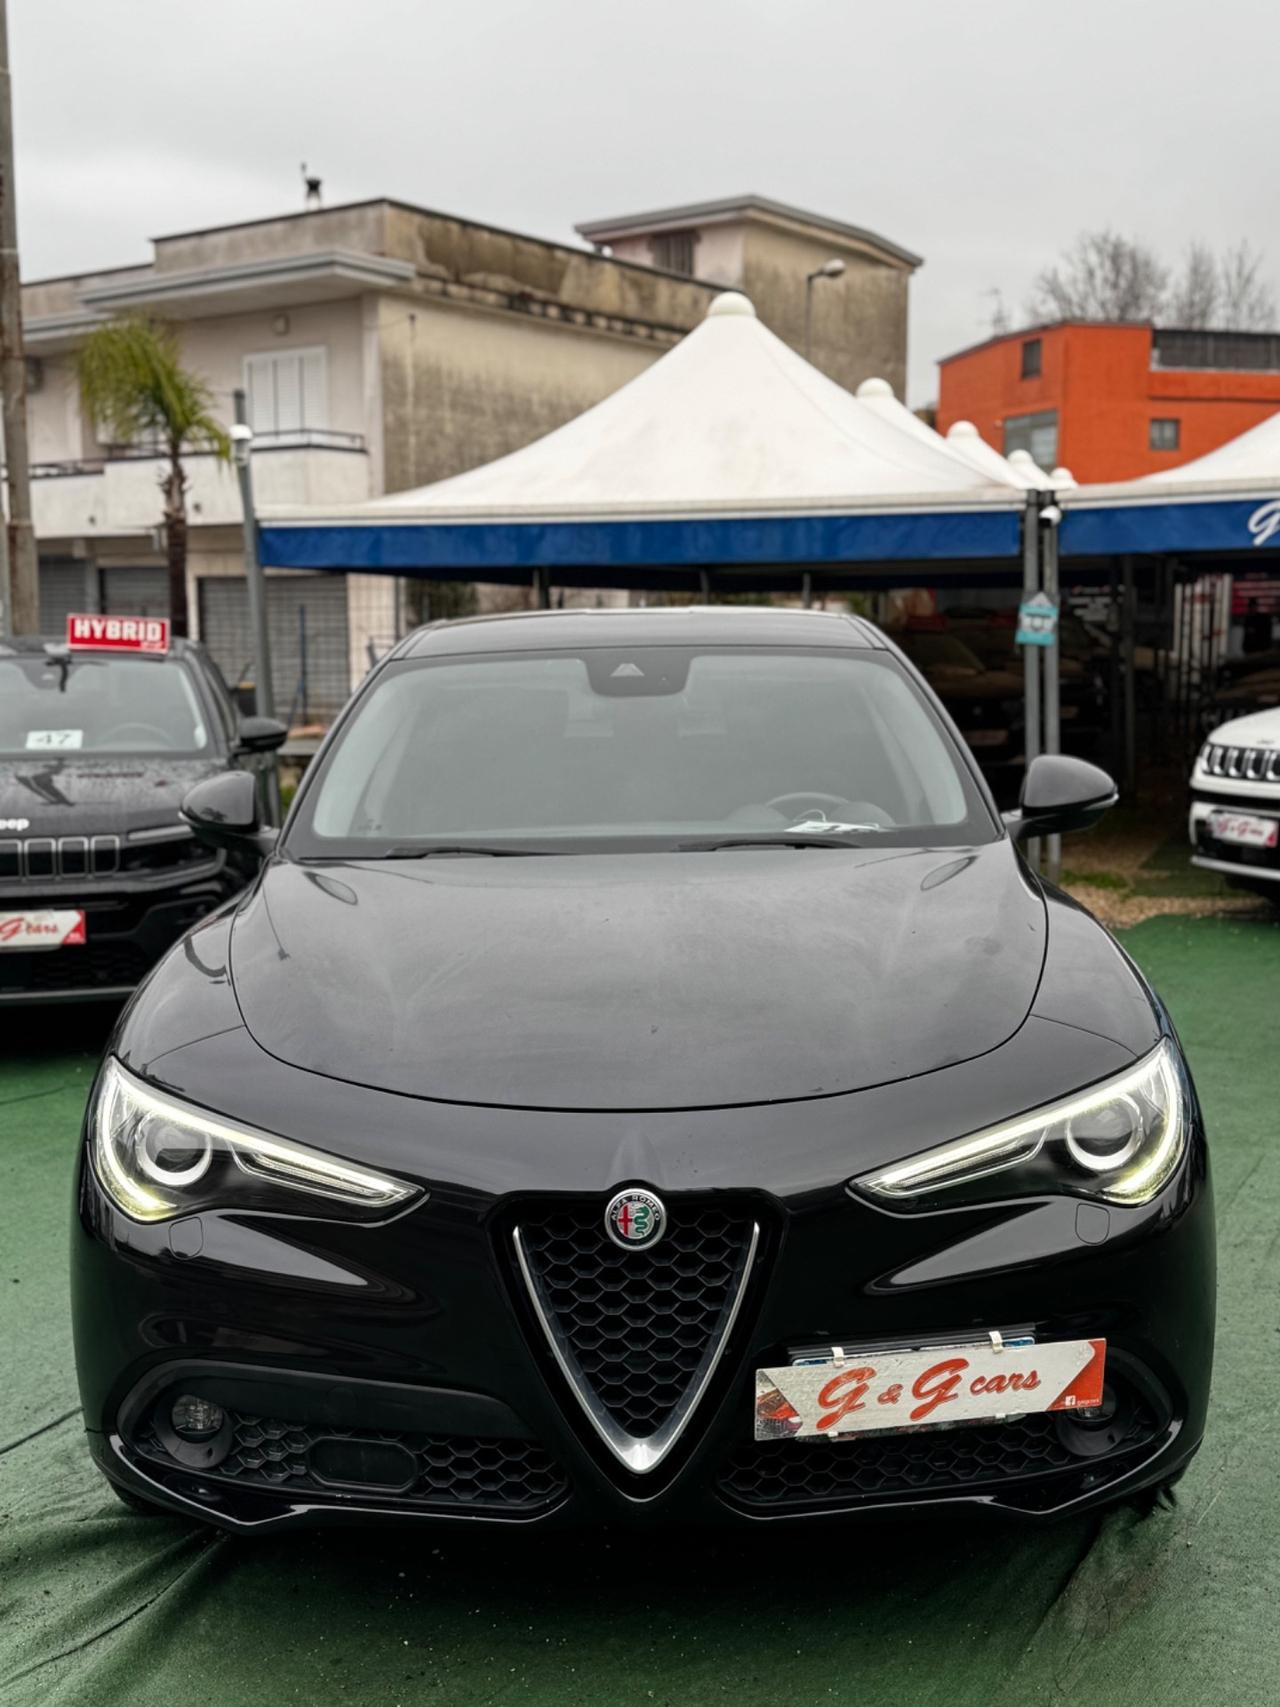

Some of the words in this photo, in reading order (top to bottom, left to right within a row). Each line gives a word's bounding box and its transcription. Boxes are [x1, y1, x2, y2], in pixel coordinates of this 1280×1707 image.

[74, 618, 161, 641] HYBRID
[0, 818, 30, 831] eep
[631, 1194, 660, 1221] ROMEO
[816, 1366, 877, 1430] G
[877, 1383, 904, 1405] &
[910, 1358, 969, 1421] G
[969, 1369, 1042, 1397] cars
